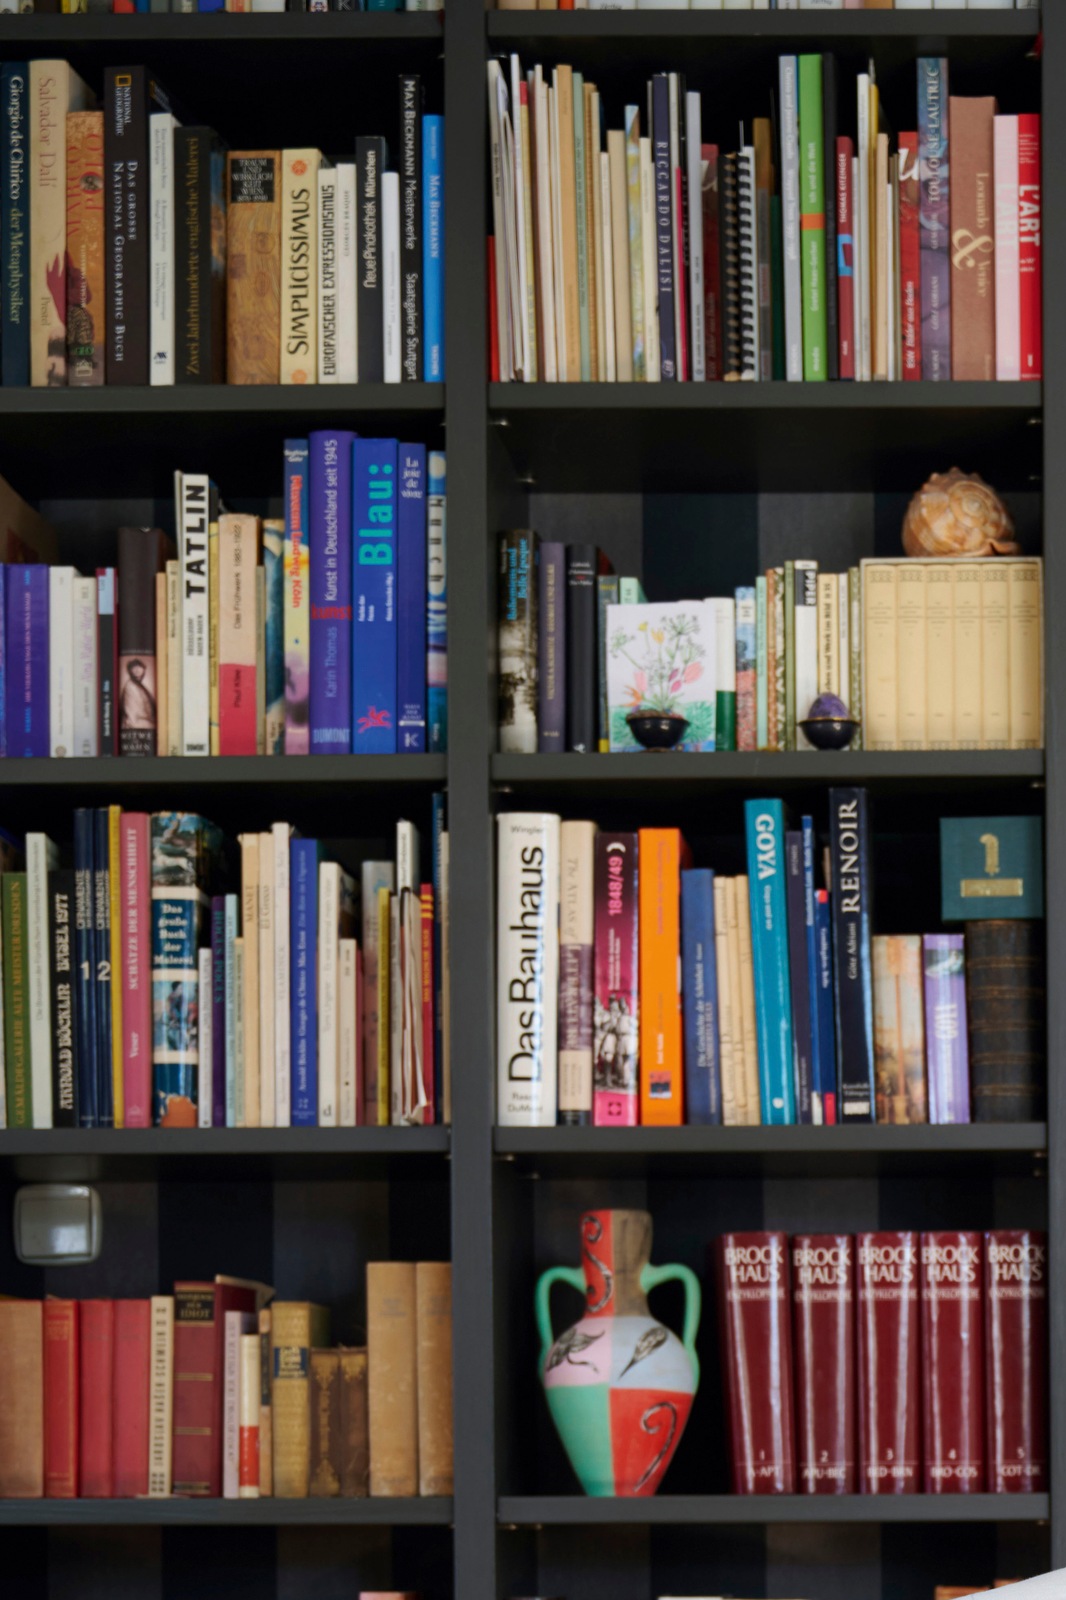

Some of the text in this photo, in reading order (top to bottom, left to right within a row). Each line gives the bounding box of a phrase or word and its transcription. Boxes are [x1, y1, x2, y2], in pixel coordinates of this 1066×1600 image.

[116, 86, 124, 136] GEOGRAPHIC
[123, 87, 131, 125] NATIONAL
[39, 77, 56, 188] Salvador Dalí
[8, 76, 23, 323] Giorgio de Chirico der Metaphysiker
[362, 151, 377, 287] Neue Pinakothek München
[429, 175, 440, 258] MAX BECKMANN
[657, 142, 671, 293] RICCARDO DALISI
[976, 172, 989, 228] Leonardo
[1019, 184, 1039, 246] L'ART
[404, 81, 419, 379] MAX BECKMANN Meisterwerke Staatsgalerie Stuttgart
[952, 228, 994, 270] &
[186, 138, 200, 375] Zwei Jahrhunderte englische Malerei
[41, 297, 51, 326] Prestel
[325, 440, 337, 601] Kunst in Deutschland seit 1945
[359, 464, 392, 565] Blau:
[185, 485, 205, 598] TATLIN
[290, 475, 303, 608] Museum Ludwig Köln
[804, 570, 815, 605] PIPER
[325, 627, 337, 697] Karin Thomas
[756, 814, 775, 879] GOYA
[838, 799, 860, 914] RENOIR
[127, 828, 138, 989] SCHÄTZE DER MENSCHHEIT
[162, 903, 183, 914] Das
[608, 856, 622, 916] 1848/49
[159, 929, 187, 939] Buch
[846, 923, 857, 954] Adriani
[80, 960, 90, 980] 1
[98, 960, 110, 980] 2
[508, 846, 545, 1082] Das Bauhaus
[724, 1246, 783, 1265] BROCK
[734, 1266, 781, 1283] HAUS
[793, 1249, 851, 1267] BROCK
[799, 1267, 847, 1285] HAUS
[859, 1246, 918, 1265] BROCK
[864, 1266, 913, 1283] HAUS
[921, 1246, 978, 1265] BROCK
[927, 1266, 975, 1283] HAUS
[989, 1246, 1044, 1264] BROCK
[995, 1265, 1043, 1282] HAUS
